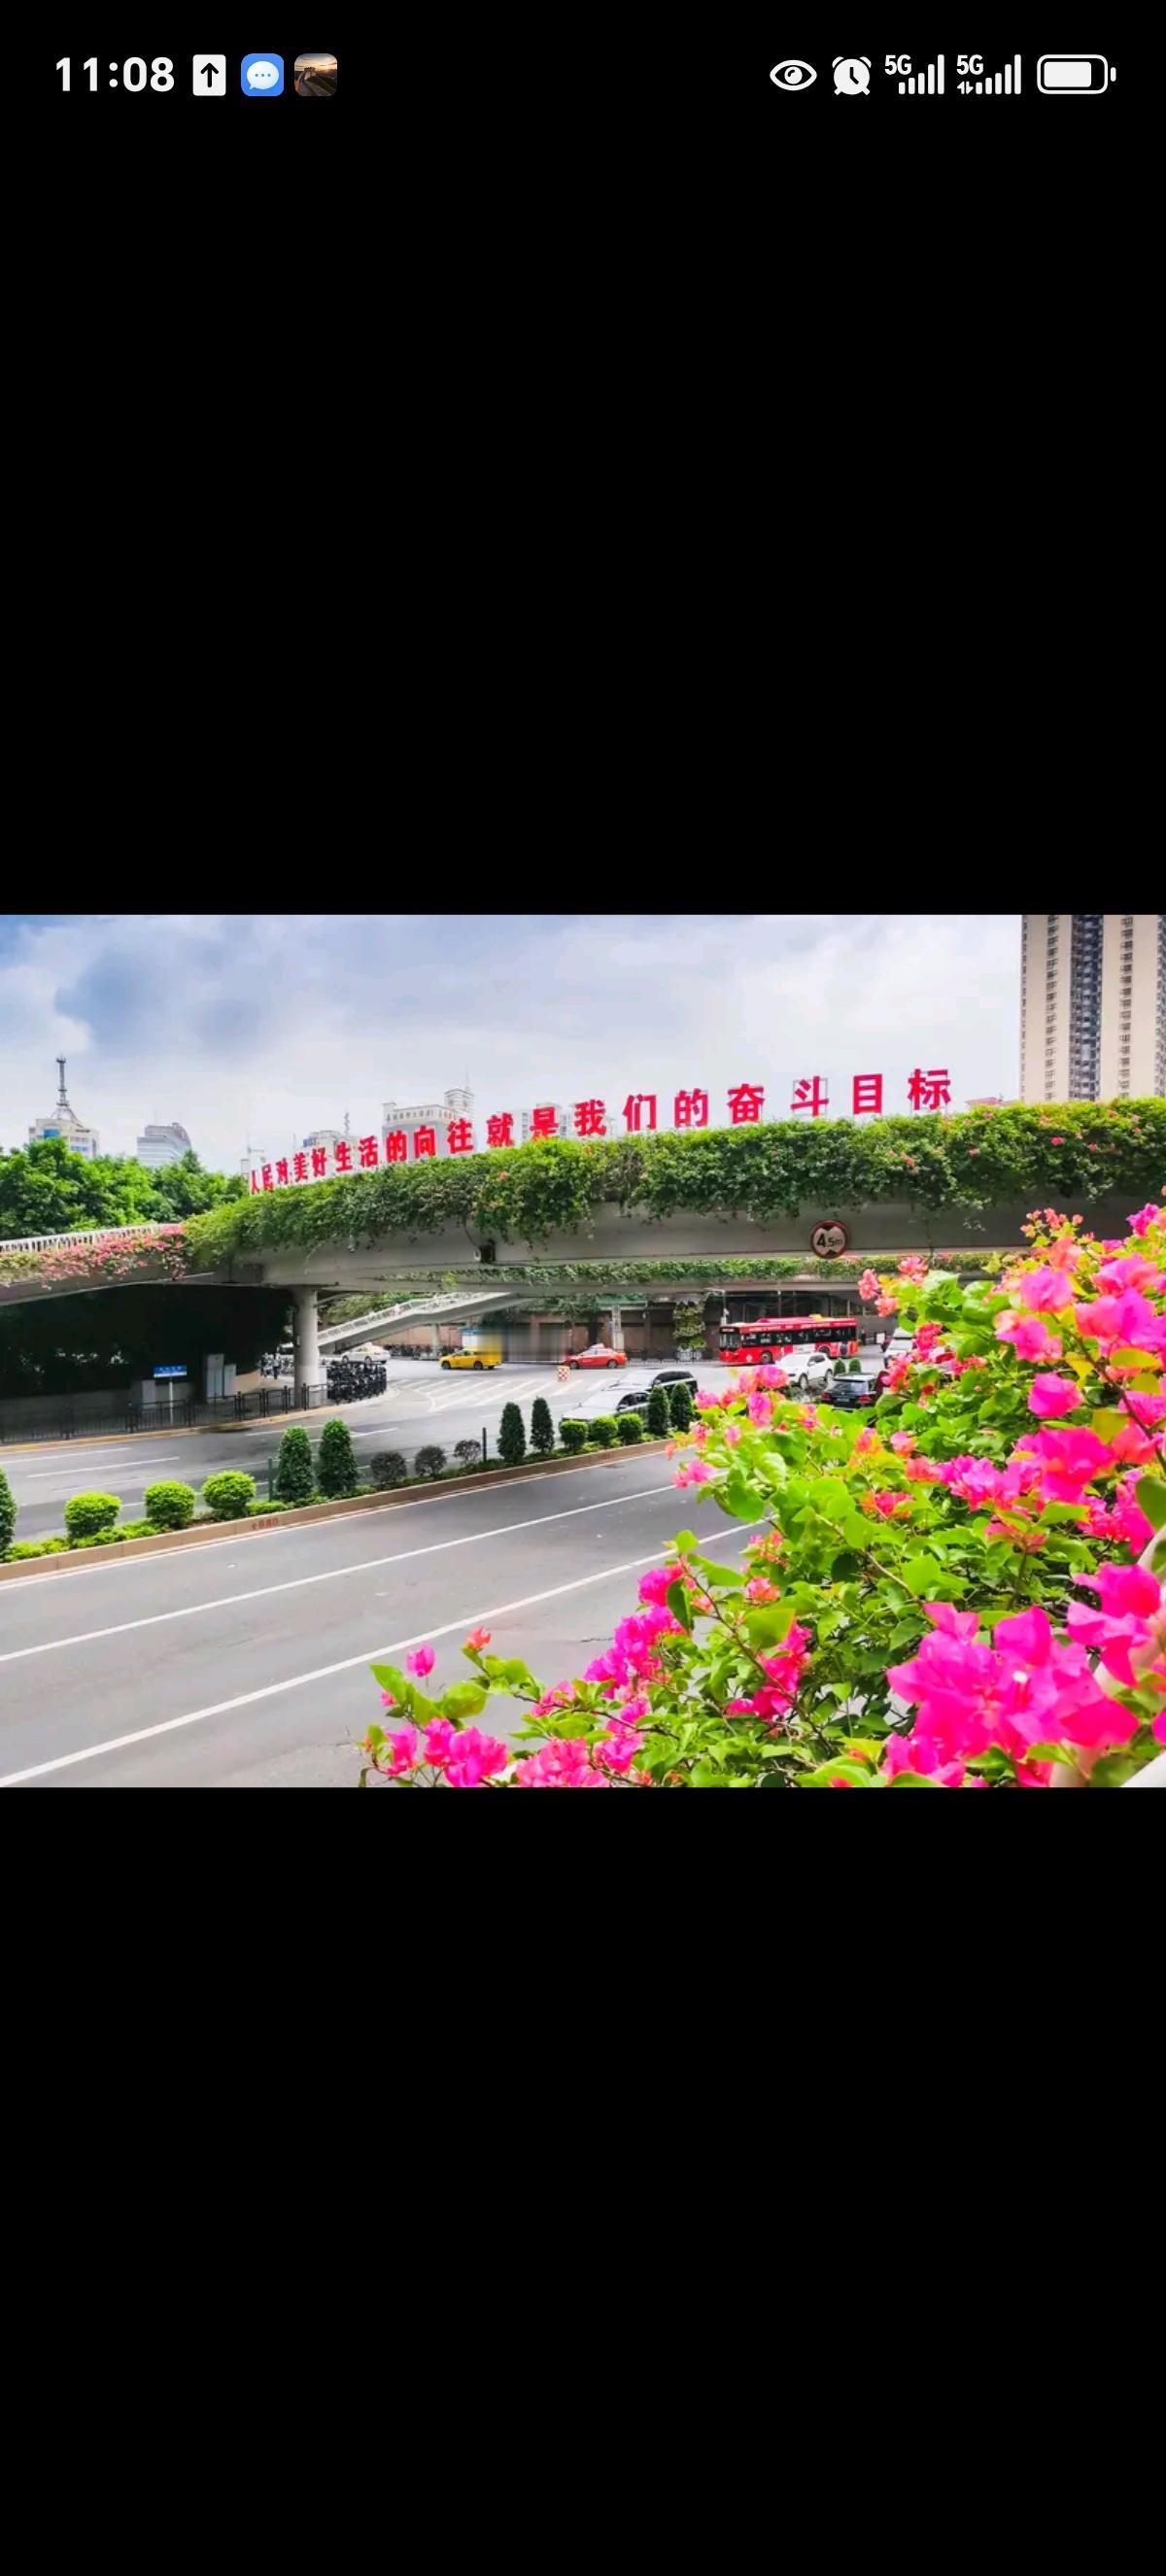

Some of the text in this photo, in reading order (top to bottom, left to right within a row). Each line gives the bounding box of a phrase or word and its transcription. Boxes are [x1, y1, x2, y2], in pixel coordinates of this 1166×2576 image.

[251, 1068, 951, 1194] 人民对美好生活的向往就是我们的奋斗目标
